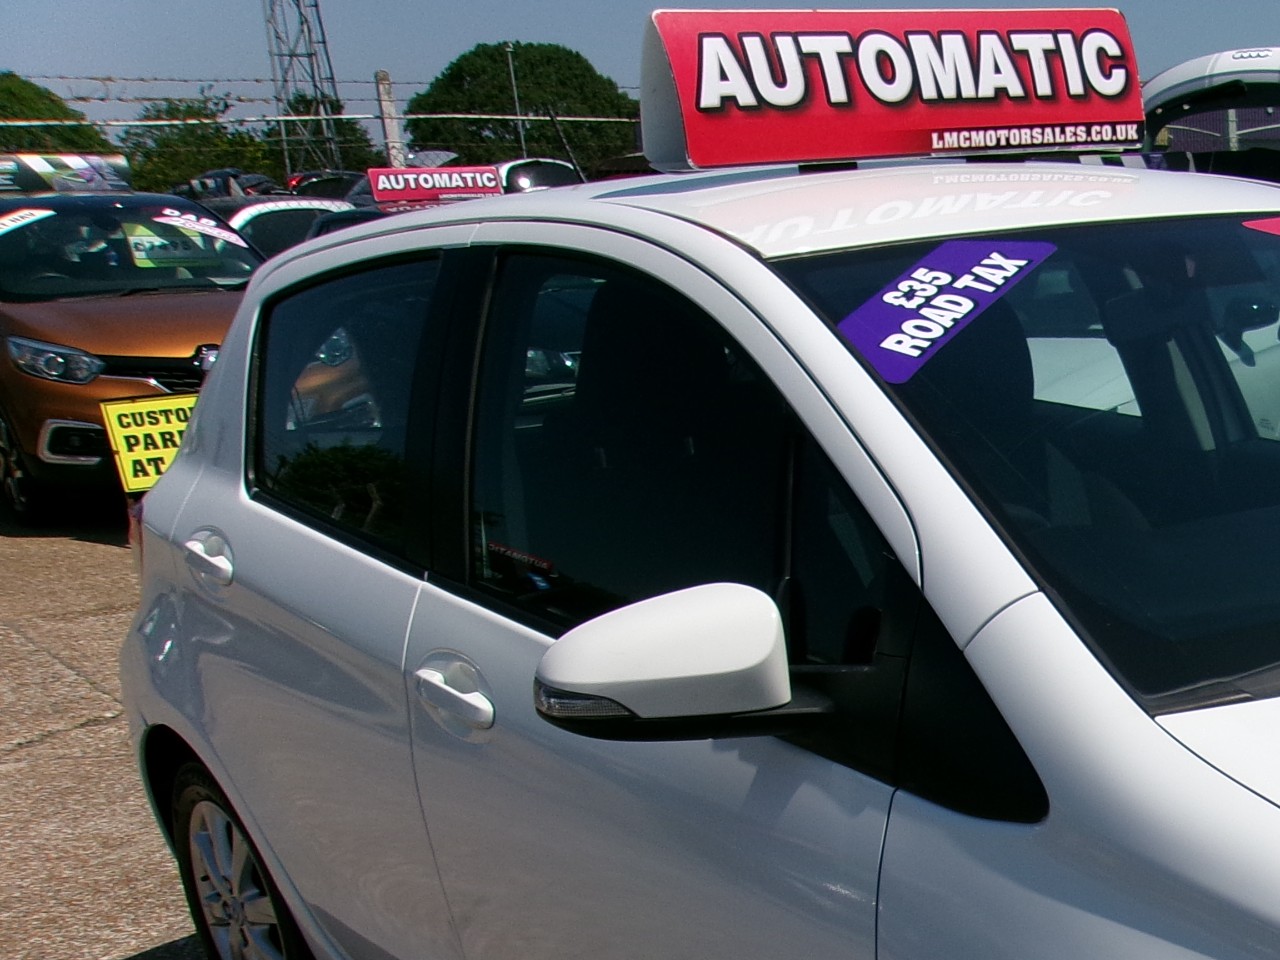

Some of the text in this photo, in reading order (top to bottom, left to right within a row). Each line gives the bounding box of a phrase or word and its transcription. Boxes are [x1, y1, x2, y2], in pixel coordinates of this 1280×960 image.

[698, 30, 1129, 111] AUTOMATIC
[931, 123, 1139, 150] LMCMOTORSALES.CO.UK
[377, 172, 497, 191] AUTOMATIC
[161, 207, 218, 227] DAB
[882, 267, 953, 309] £35
[879, 251, 1029, 358] ROAD TAX
[131, 456, 167, 478] AT
